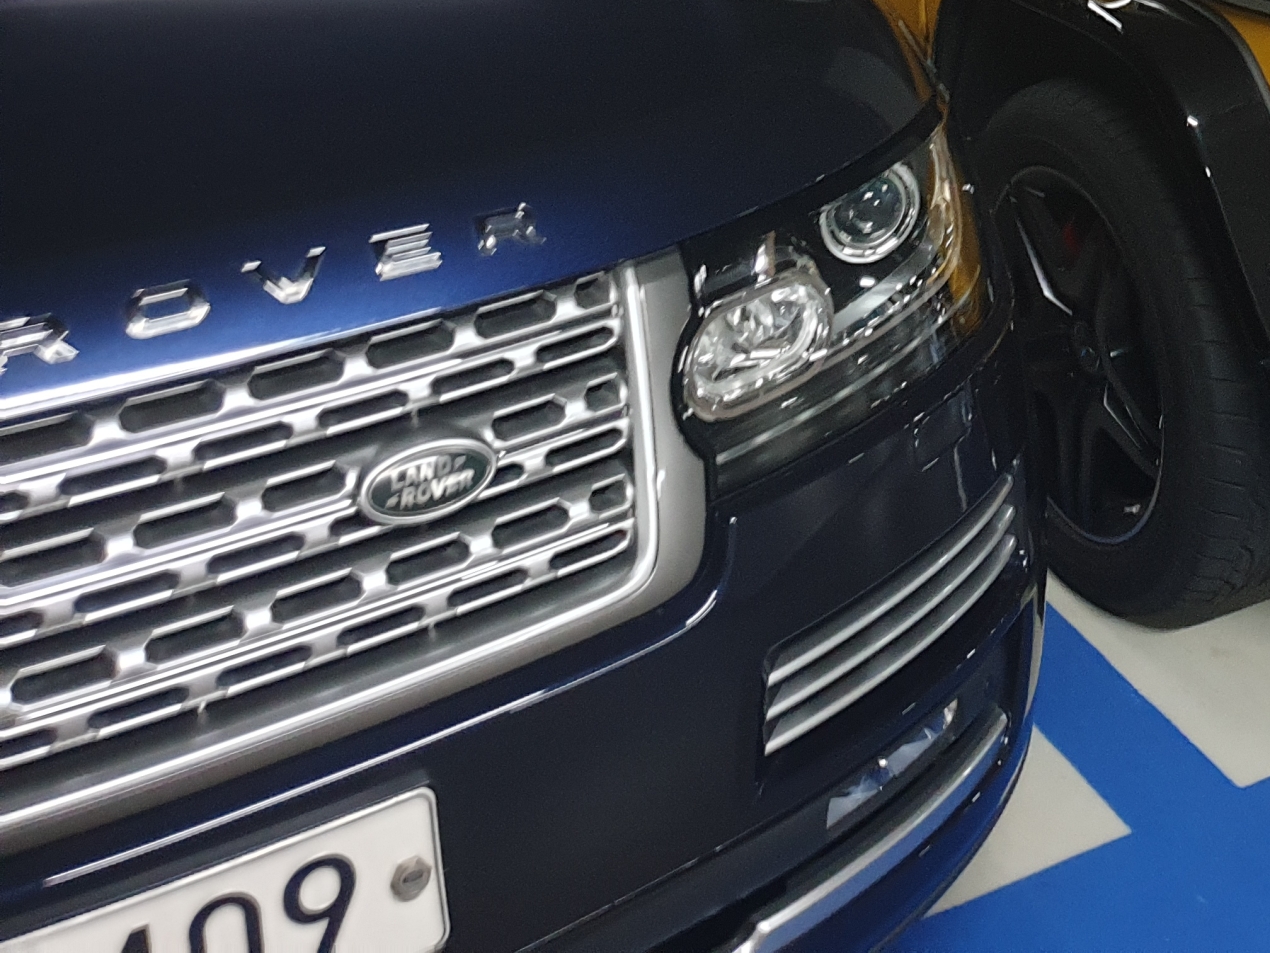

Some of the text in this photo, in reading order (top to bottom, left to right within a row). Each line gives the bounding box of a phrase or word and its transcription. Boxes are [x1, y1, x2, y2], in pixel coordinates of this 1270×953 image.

[0, 202, 546, 376] ROVER
[390, 455, 452, 492] LAND
[400, 468, 475, 510] ROVER
[120, 853, 356, 953] 09
